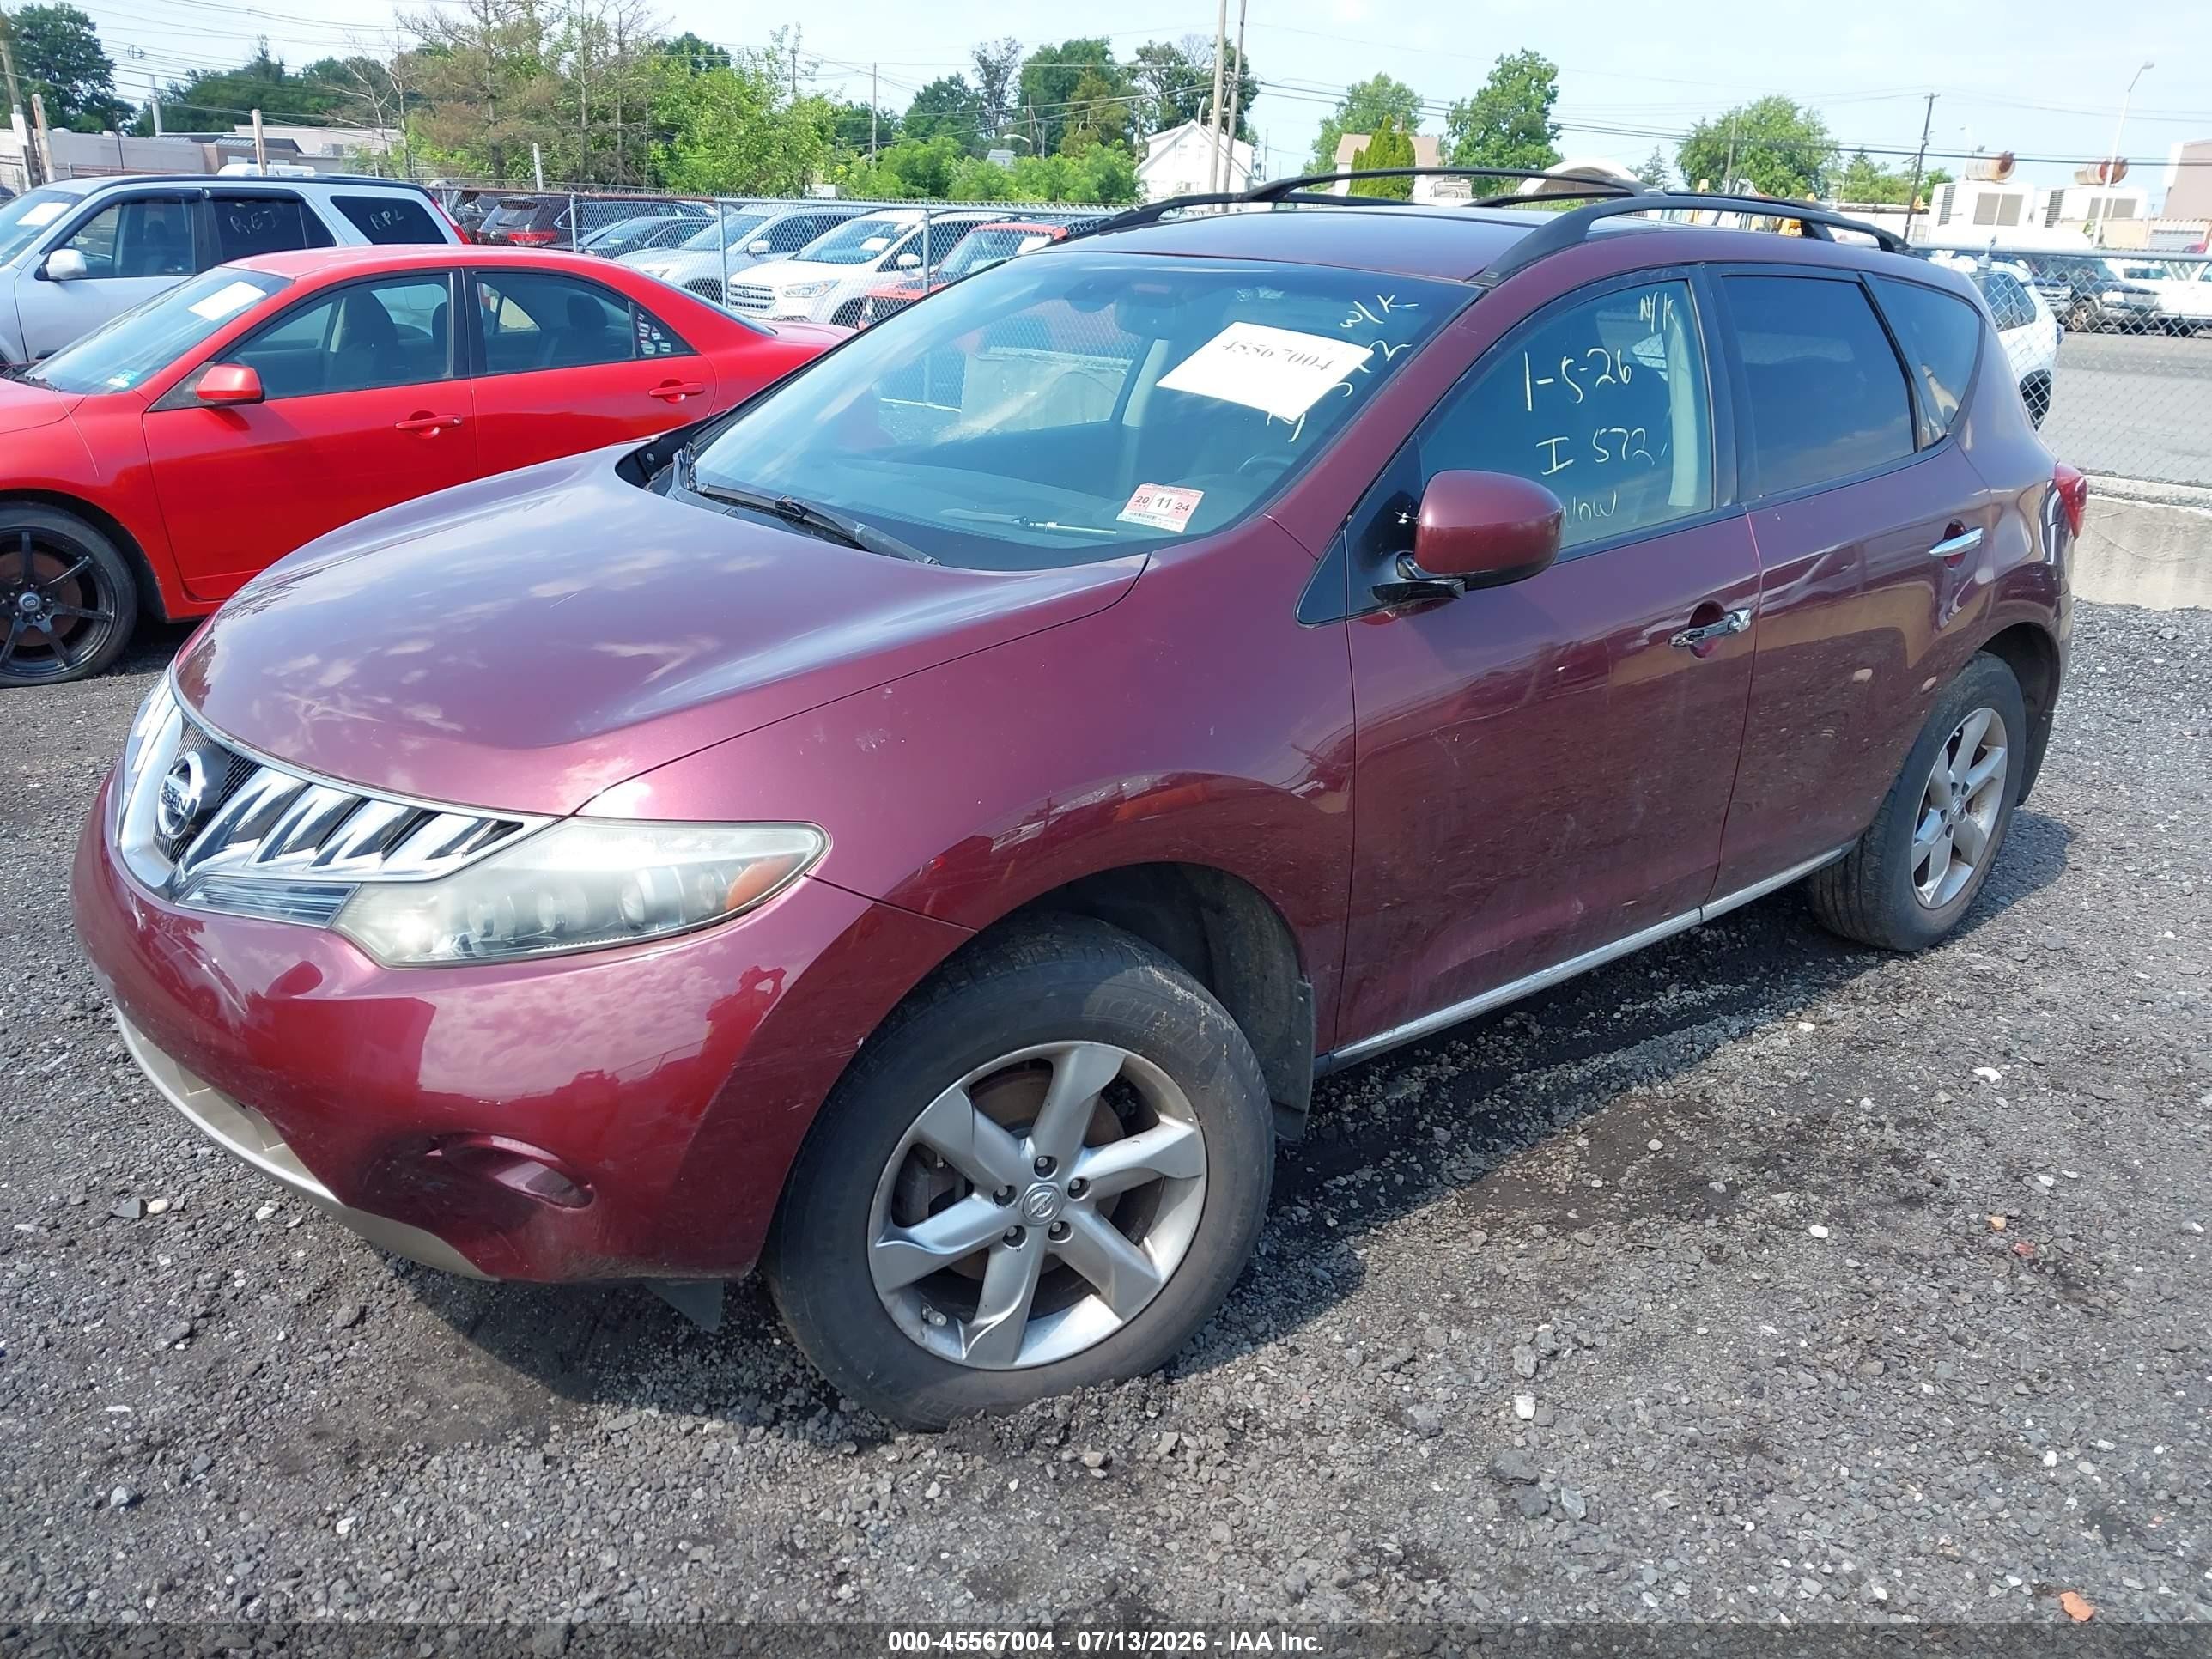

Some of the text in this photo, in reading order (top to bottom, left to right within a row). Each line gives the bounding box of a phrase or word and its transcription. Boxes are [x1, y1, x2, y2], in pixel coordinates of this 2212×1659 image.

[1134, 495, 1191, 512] 20 11 24
